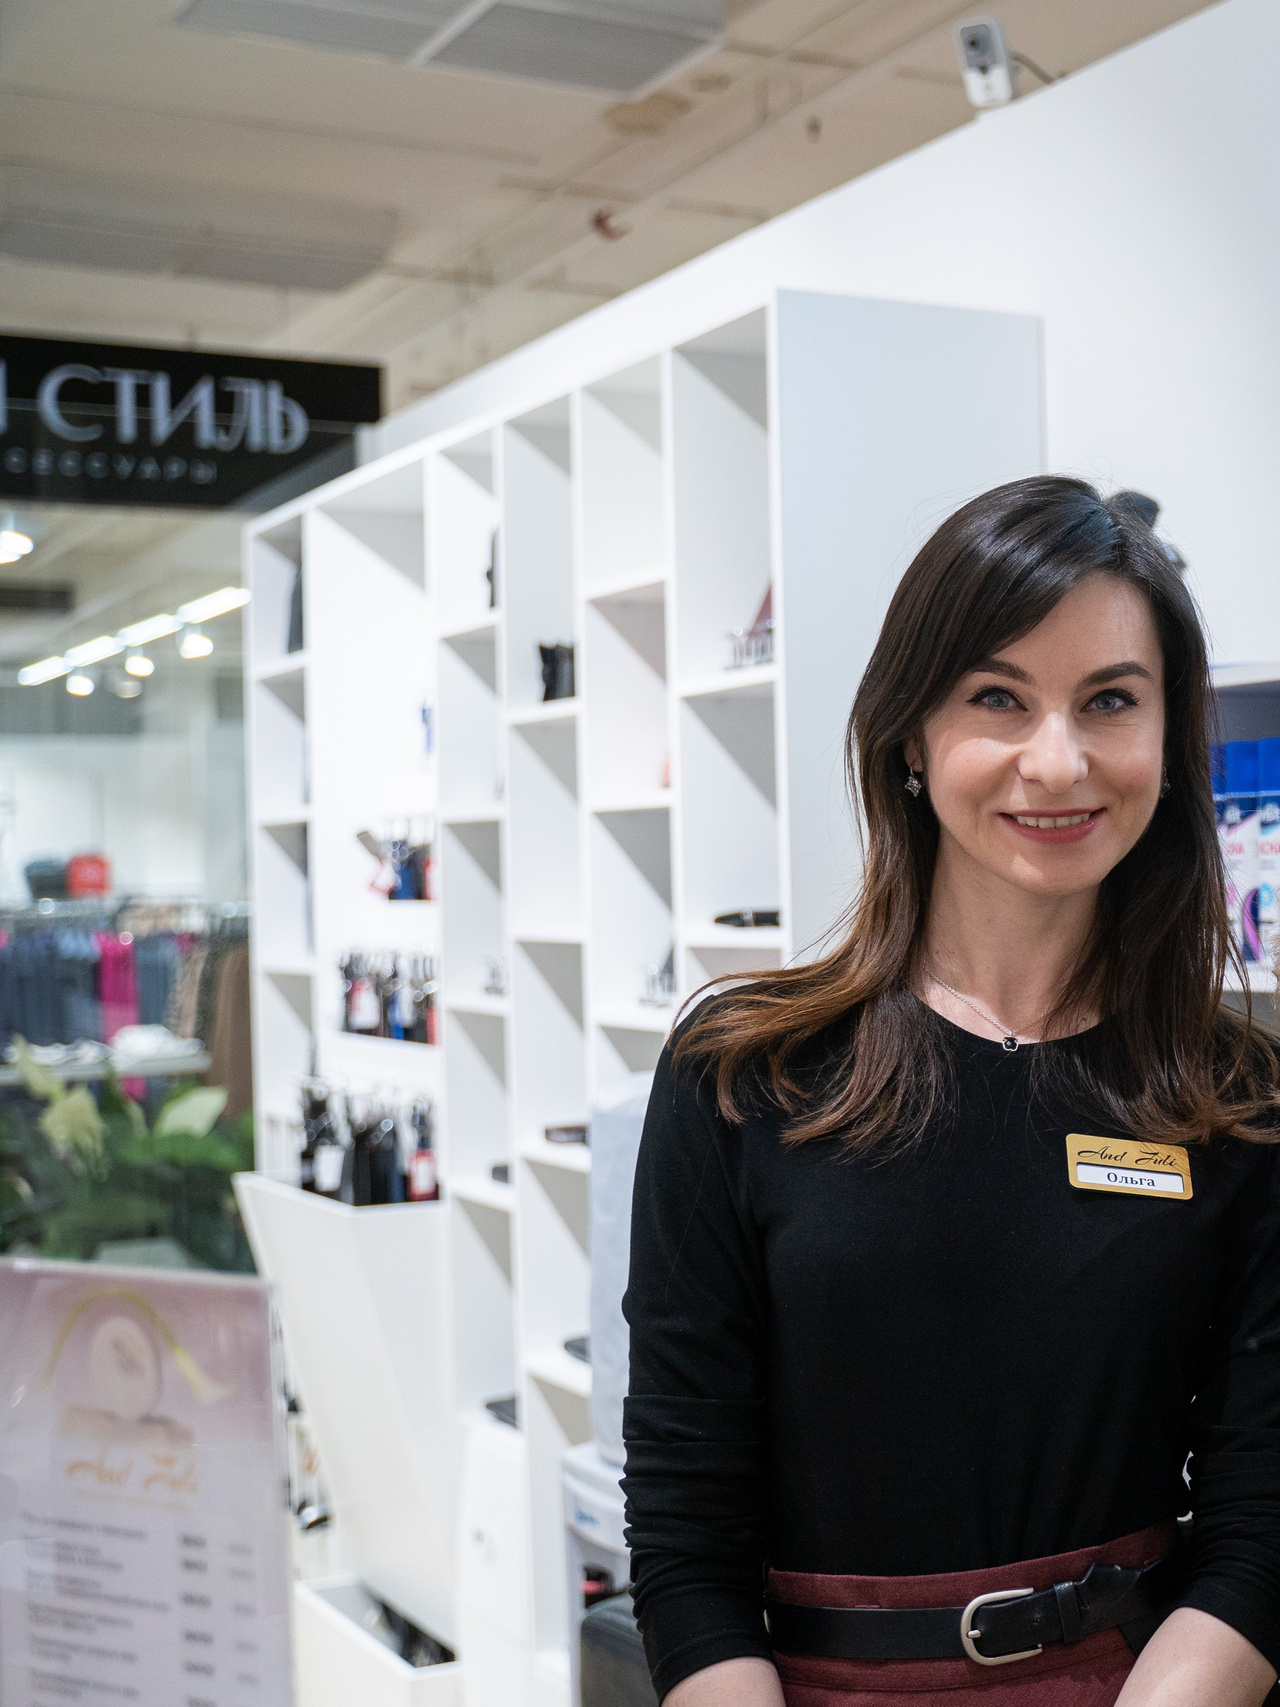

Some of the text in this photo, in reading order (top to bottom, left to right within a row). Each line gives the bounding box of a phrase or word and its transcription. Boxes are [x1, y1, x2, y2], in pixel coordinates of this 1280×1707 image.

[36, 362, 310, 454] СТИЛЬ
[1077, 1146, 1127, 1163] And
[1107, 1172, 1156, 1187] Ольга
